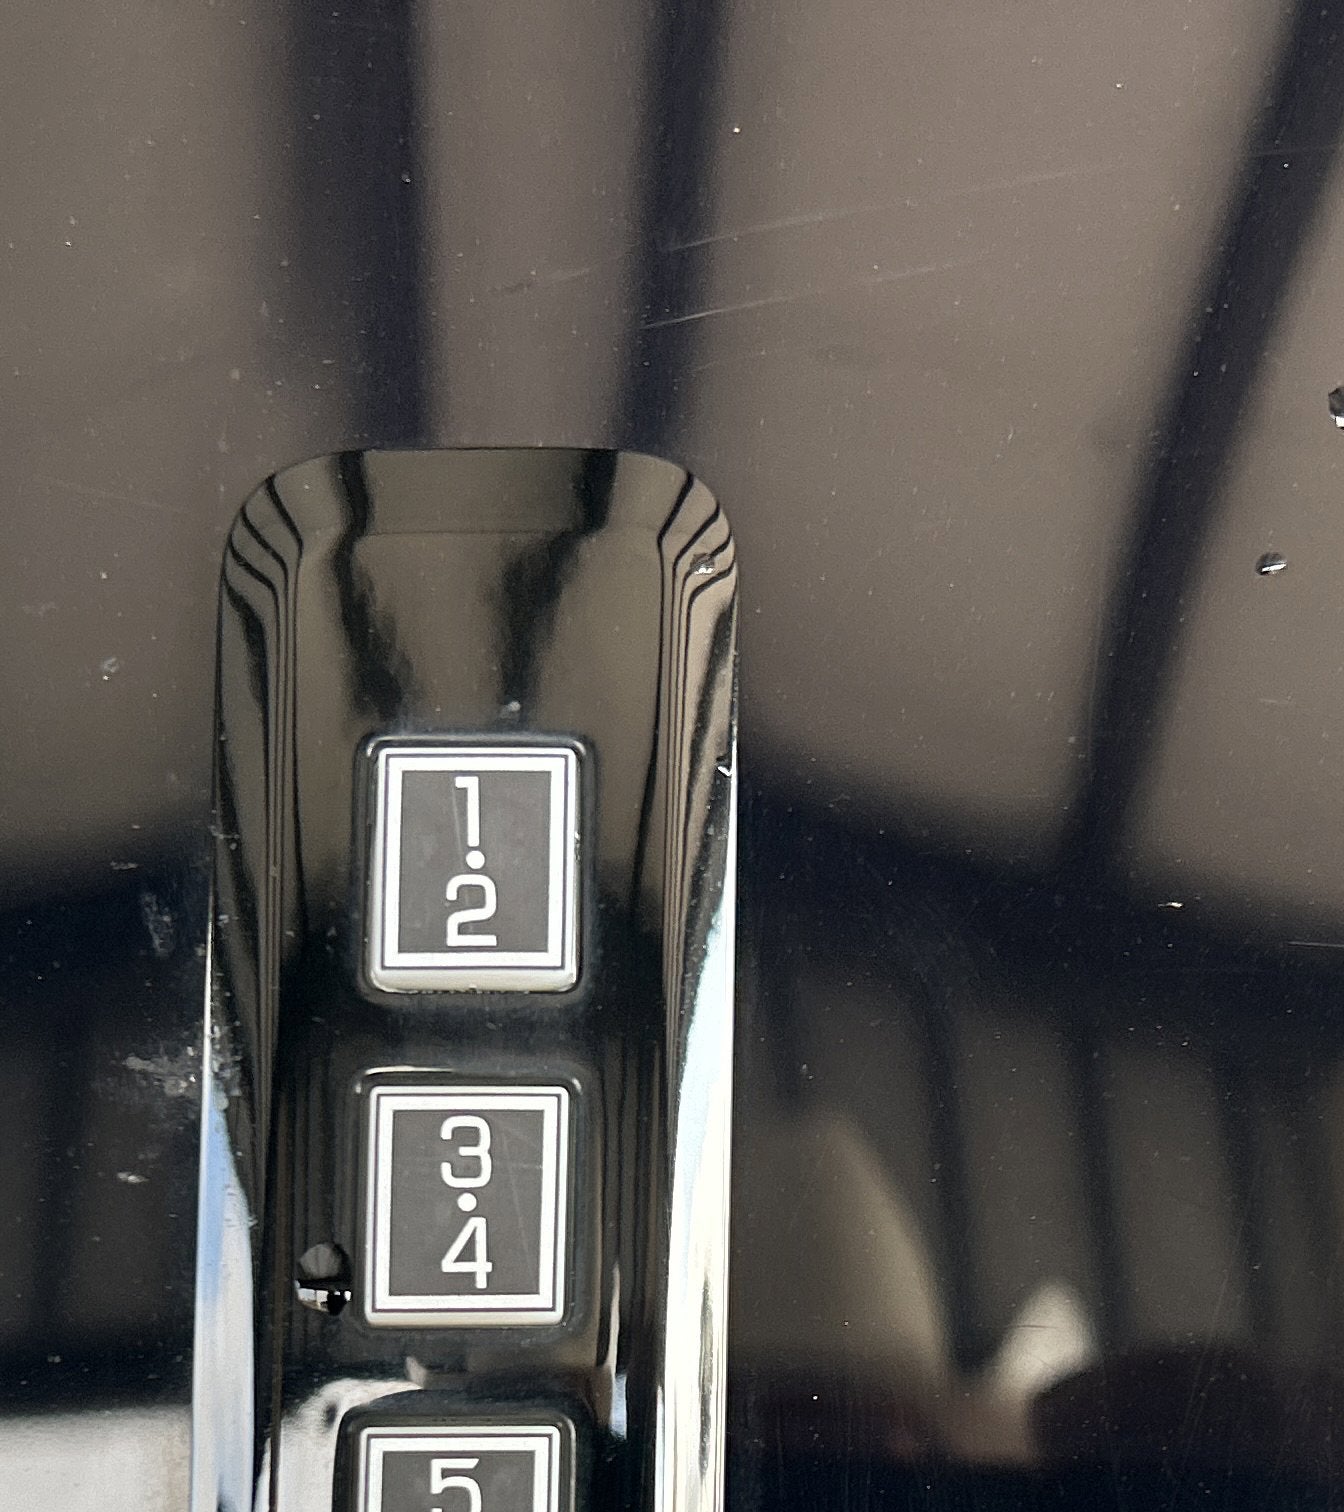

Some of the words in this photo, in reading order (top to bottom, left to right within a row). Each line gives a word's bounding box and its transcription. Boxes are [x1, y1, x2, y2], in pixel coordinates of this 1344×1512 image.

[453, 775, 481, 849] 1
[445, 873, 498, 948] 2
[439, 1114, 492, 1189] 3
[440, 1216, 493, 1290] 4
